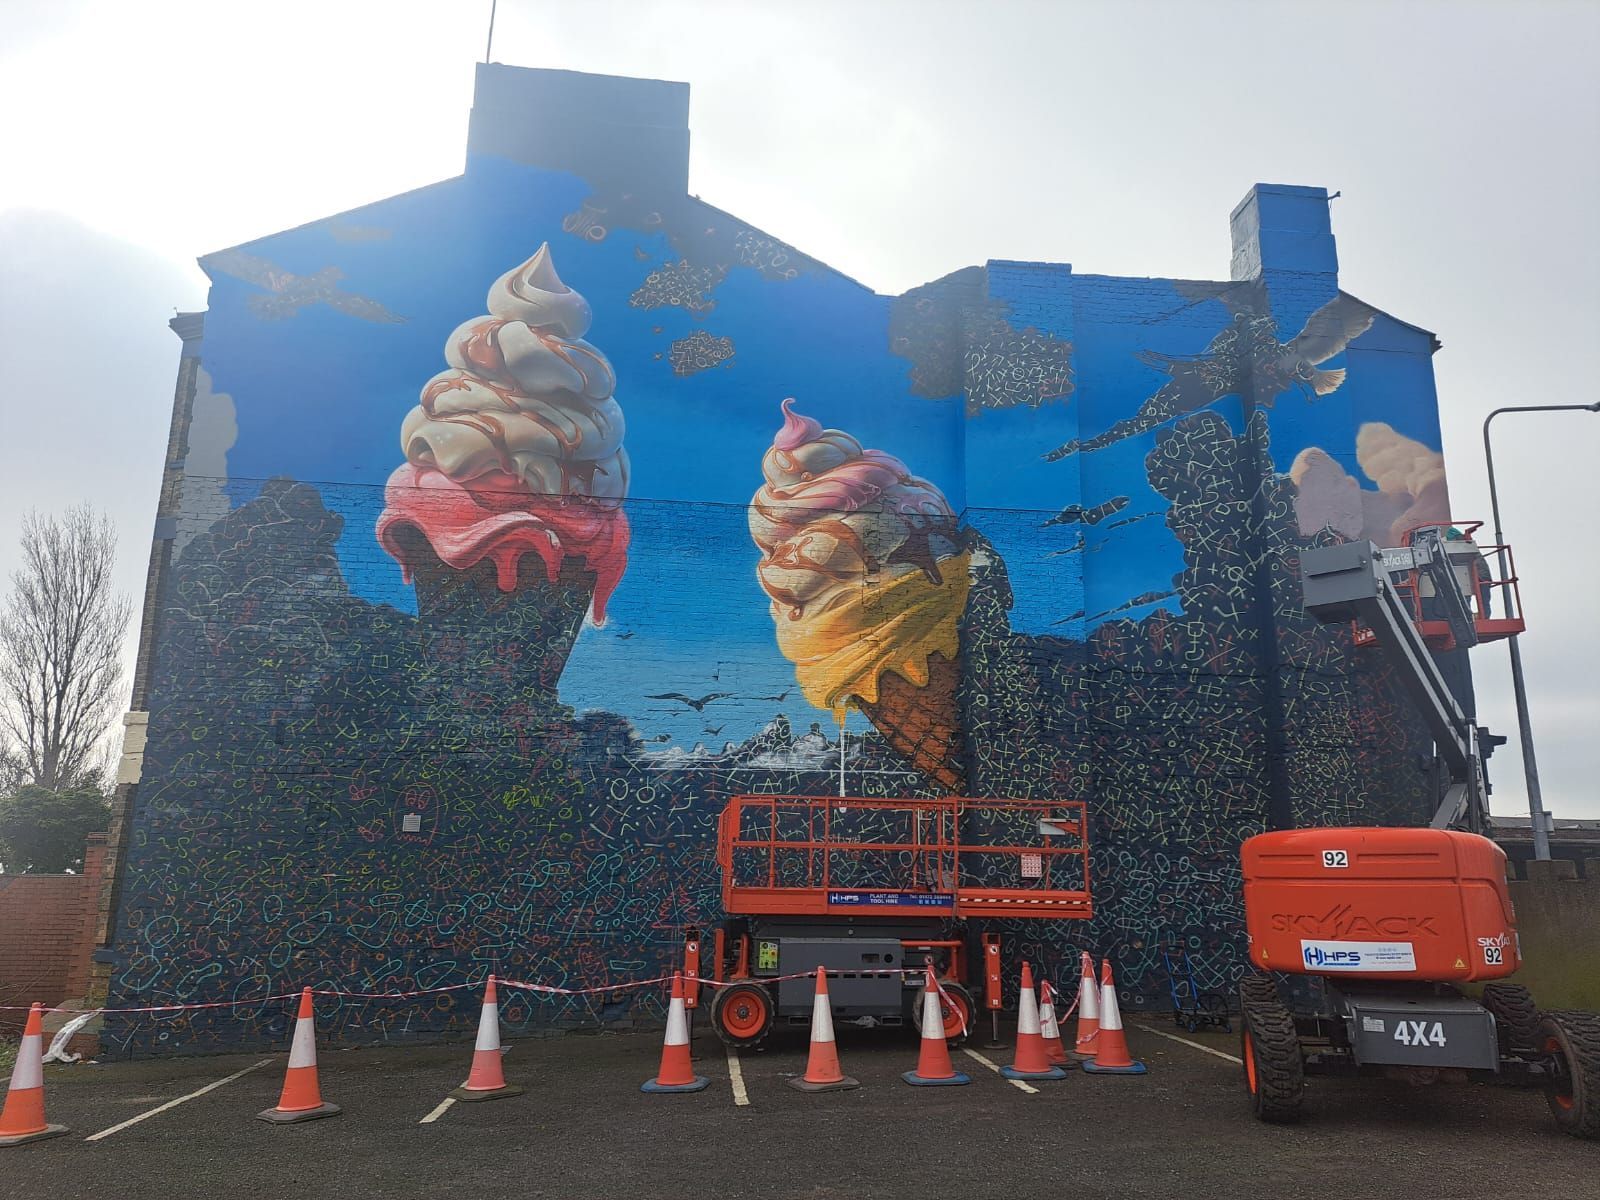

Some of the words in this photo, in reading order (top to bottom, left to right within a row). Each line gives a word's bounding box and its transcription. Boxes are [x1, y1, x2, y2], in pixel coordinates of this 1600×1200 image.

[1324, 852, 1347, 866] 92
[1271, 904, 1439, 938] SKYJACK
[1323, 952, 1361, 961] HPS
[1485, 948, 1502, 963] 92
[1394, 1021, 1447, 1047] 4X4
